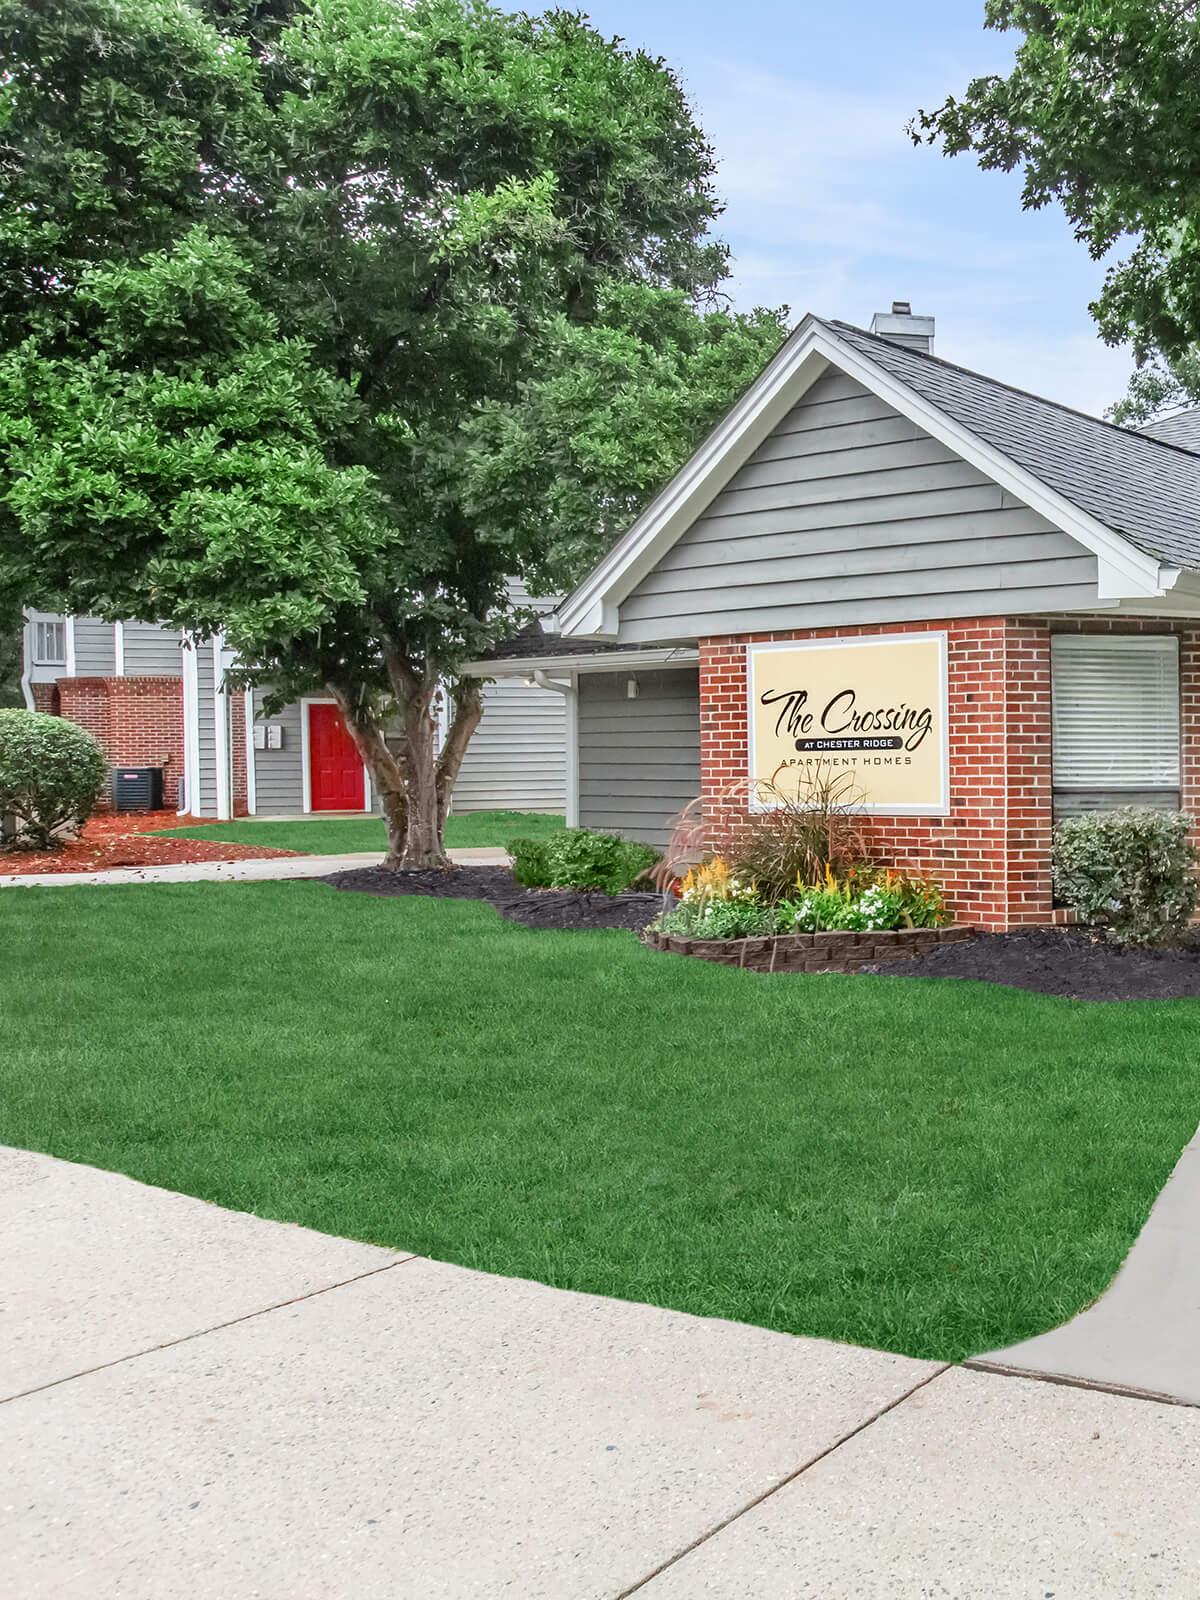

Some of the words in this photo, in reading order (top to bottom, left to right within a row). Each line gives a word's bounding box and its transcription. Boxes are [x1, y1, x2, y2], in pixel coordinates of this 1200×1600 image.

[761, 689, 813, 738] The
[820, 689, 932, 751] Crossing
[817, 740, 859, 749] CHESTER
[863, 739, 894, 748] RIDGE
[781, 758, 857, 766] APARTMENT
[863, 756, 912, 765] HOMES
